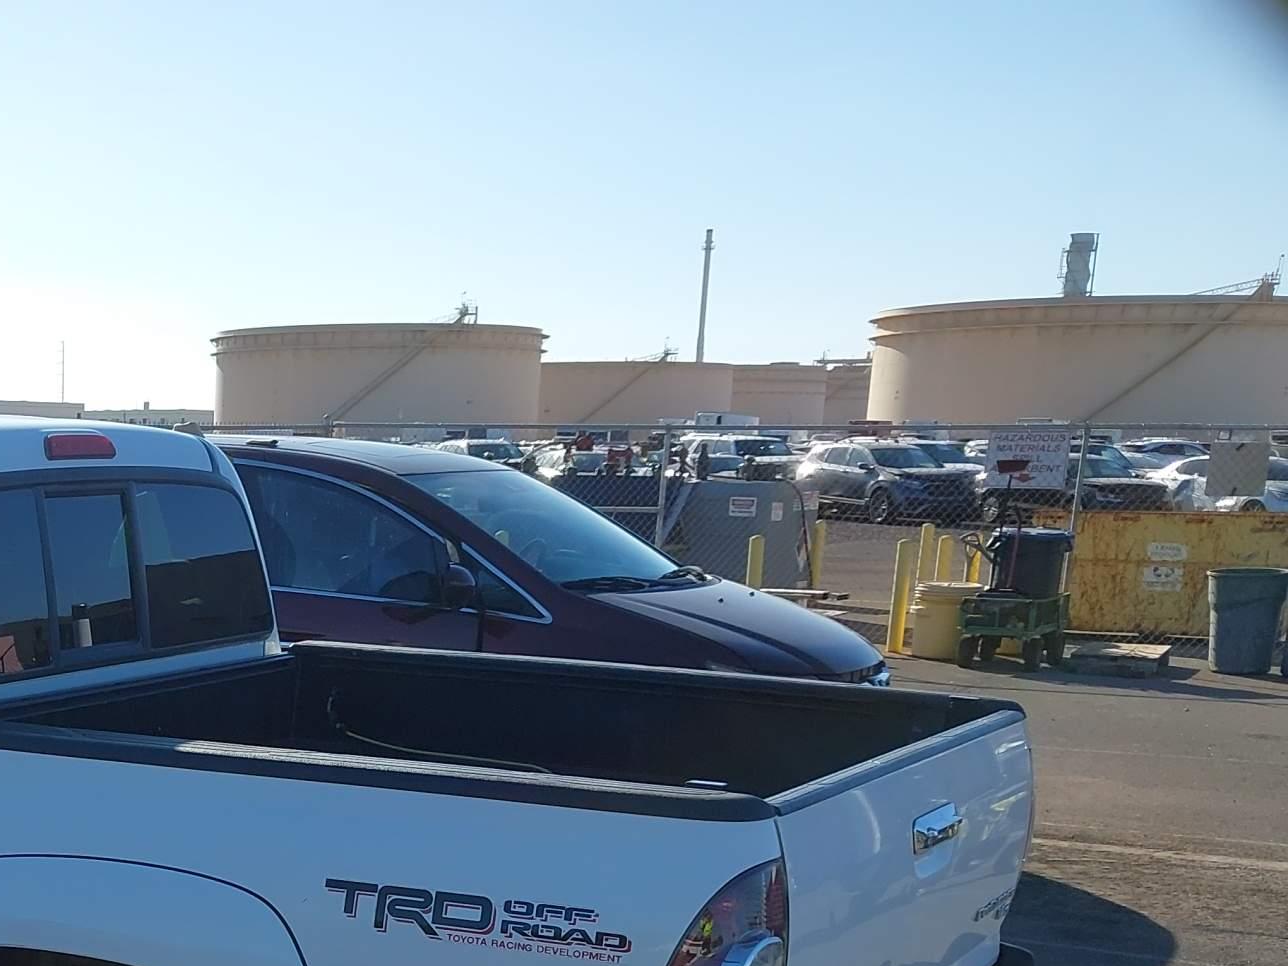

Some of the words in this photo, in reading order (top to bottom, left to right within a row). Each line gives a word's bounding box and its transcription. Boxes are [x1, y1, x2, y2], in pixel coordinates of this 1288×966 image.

[993, 433, 1066, 442] HAZARDOUS
[996, 443, 1061, 453] MATERIALS
[325, 878, 496, 940] TRD
[503, 900, 599, 925] OFF
[447, 933, 487, 947] TOYOTA
[491, 938, 532, 952] RACING
[536, 944, 622, 965] DEVELOPMENT
[500, 919, 632, 953] ROAD
